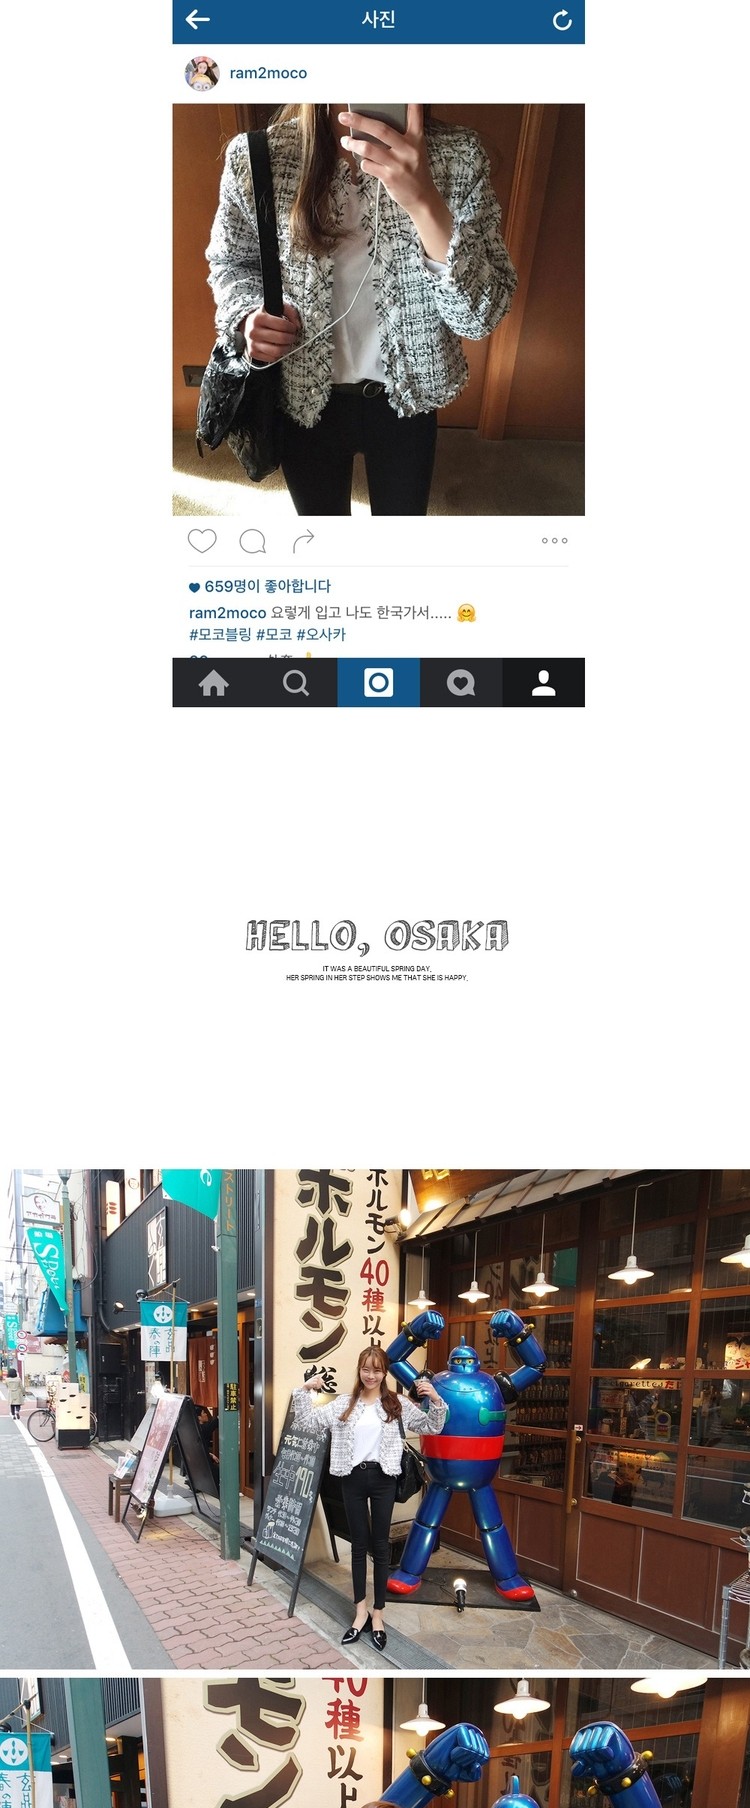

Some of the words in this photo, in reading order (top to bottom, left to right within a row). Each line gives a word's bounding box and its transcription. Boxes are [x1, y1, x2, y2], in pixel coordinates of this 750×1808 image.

[361, 9, 395, 29] 사진
[230, 66, 308, 80] ram2moco
[204, 578, 260, 594] 659명이
[264, 578, 332, 594] 좋아합니다
[189, 606, 267, 620] ram2moco
[270, 605, 311, 621] 요렇게
[315, 605, 342, 620] 입고
[345, 605, 373, 620] 나도
[189, 627, 251, 642] #모코블링
[255, 628, 293, 641] #모코
[296, 627, 347, 642] #오사카
